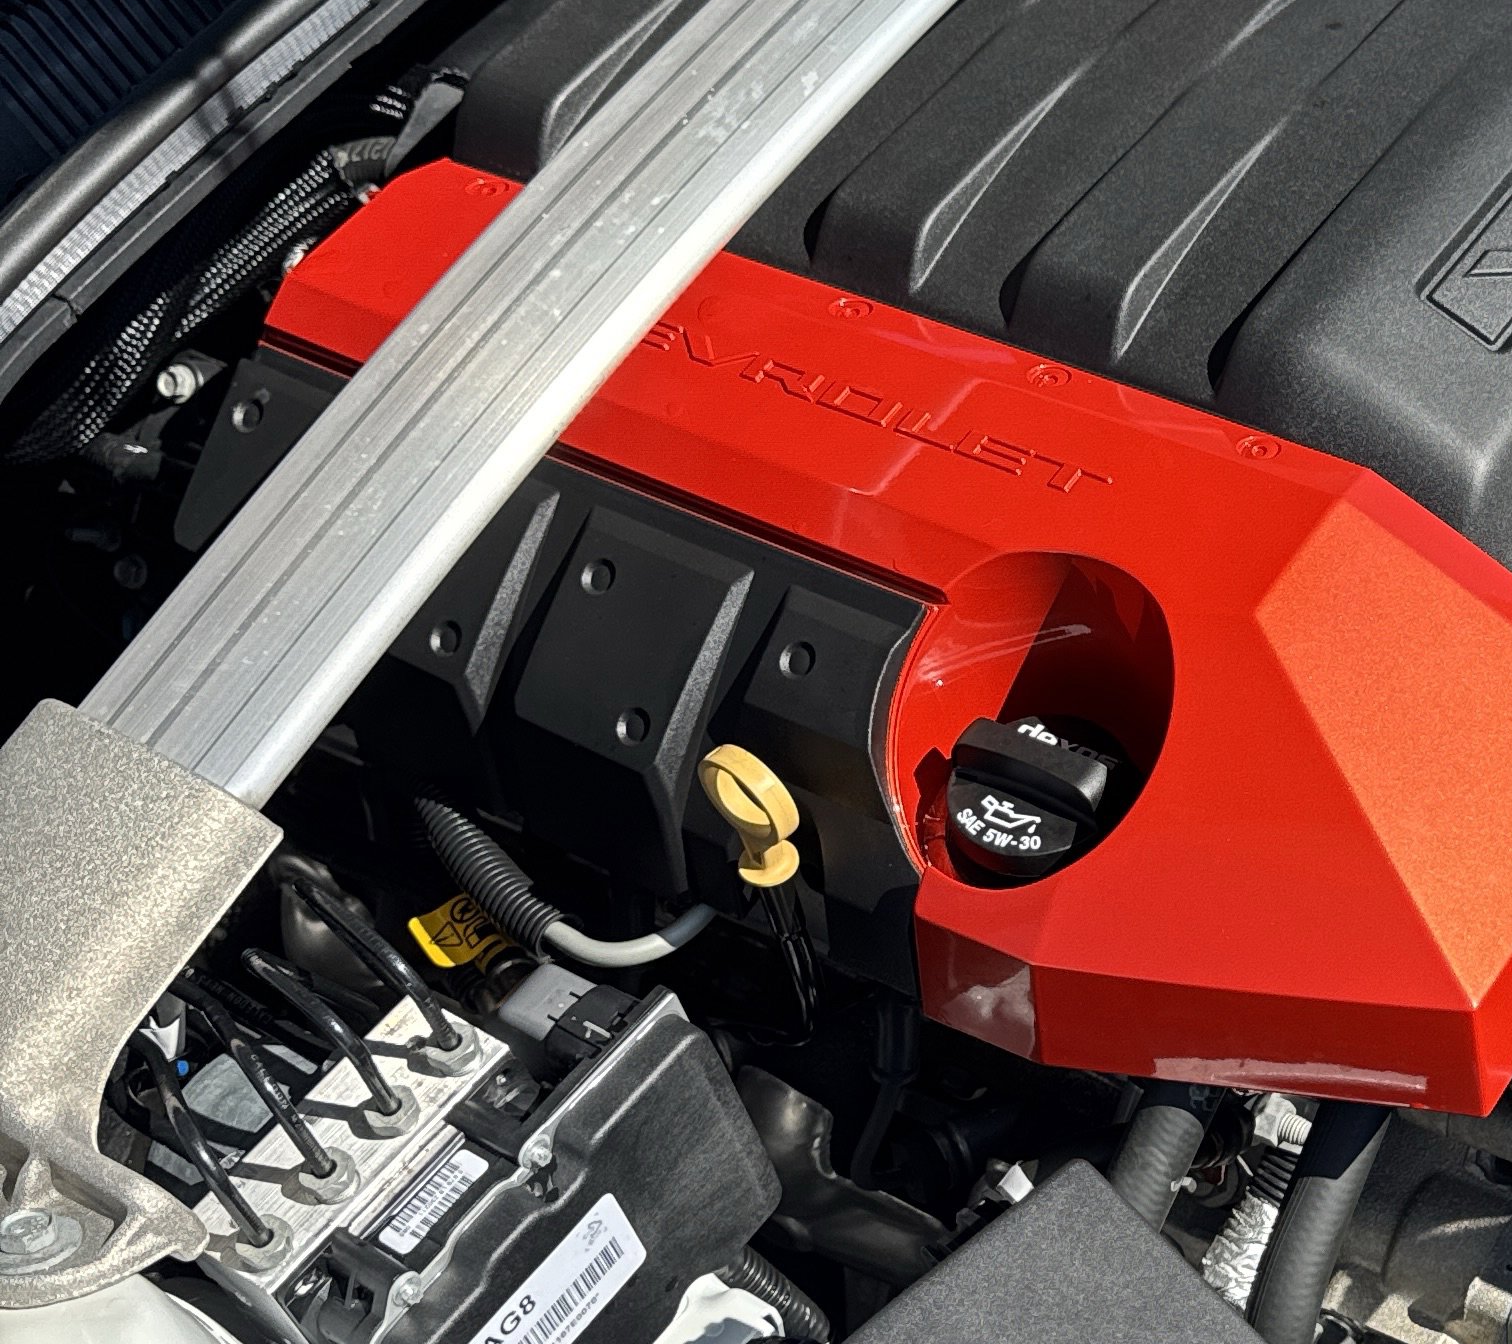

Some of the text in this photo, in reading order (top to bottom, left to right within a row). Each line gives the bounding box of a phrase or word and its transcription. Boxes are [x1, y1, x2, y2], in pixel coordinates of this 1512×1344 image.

[640, 318, 1114, 494] EVROLET
[956, 808, 1042, 851] SAE 5W-30
